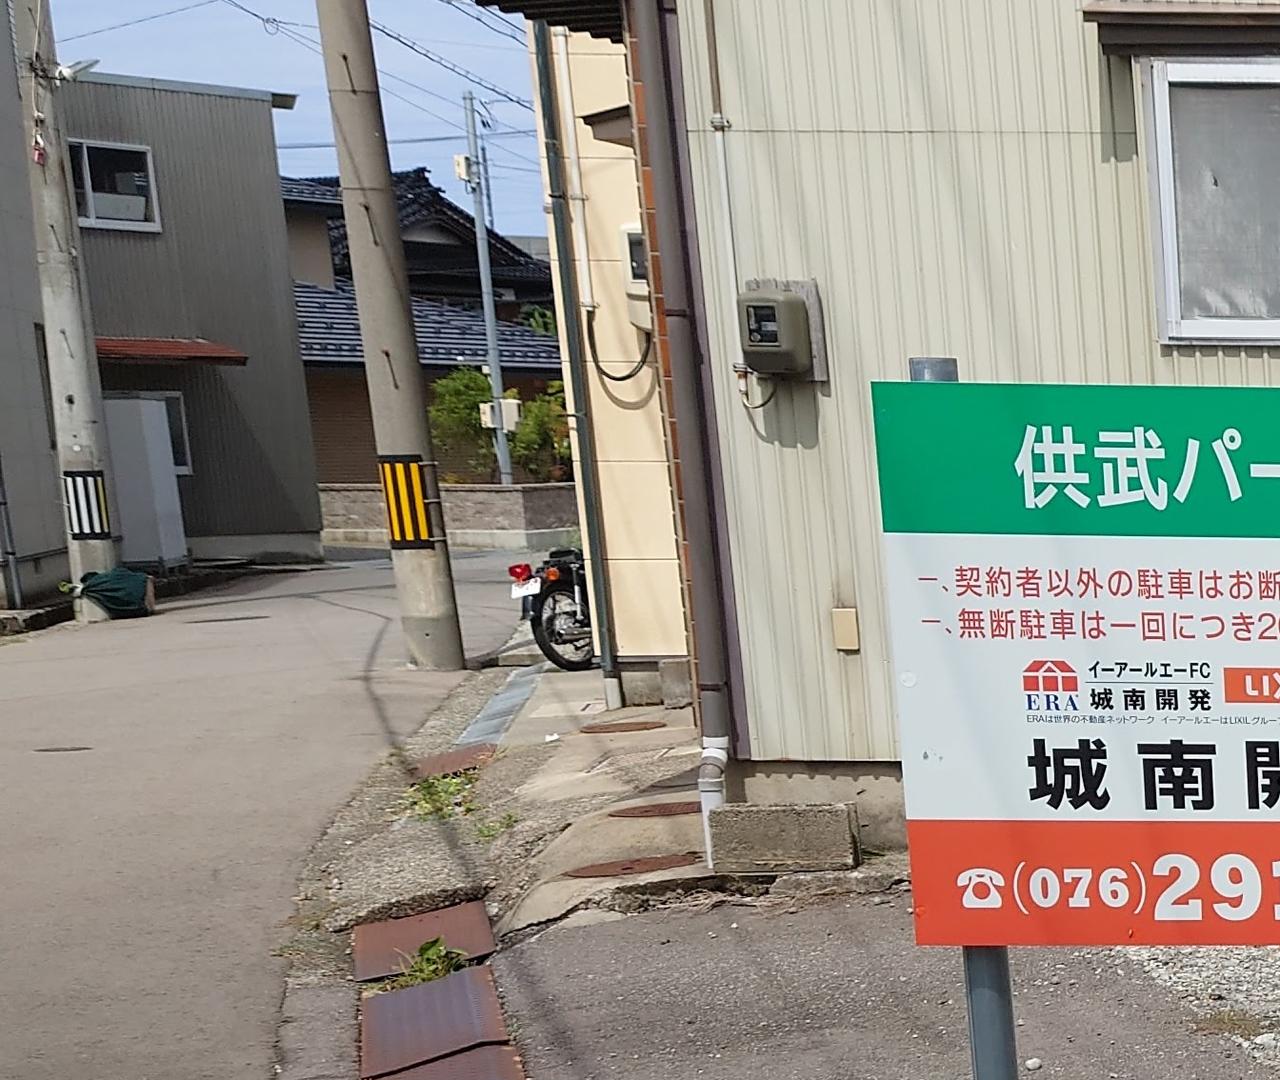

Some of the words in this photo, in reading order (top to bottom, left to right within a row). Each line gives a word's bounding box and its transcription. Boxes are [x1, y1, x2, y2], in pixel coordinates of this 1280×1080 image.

[1088, 660, 1211, 679] イーアールエーFC
[1026, 693, 1079, 711] ERA
[1090, 688, 1212, 711] 城南開発
